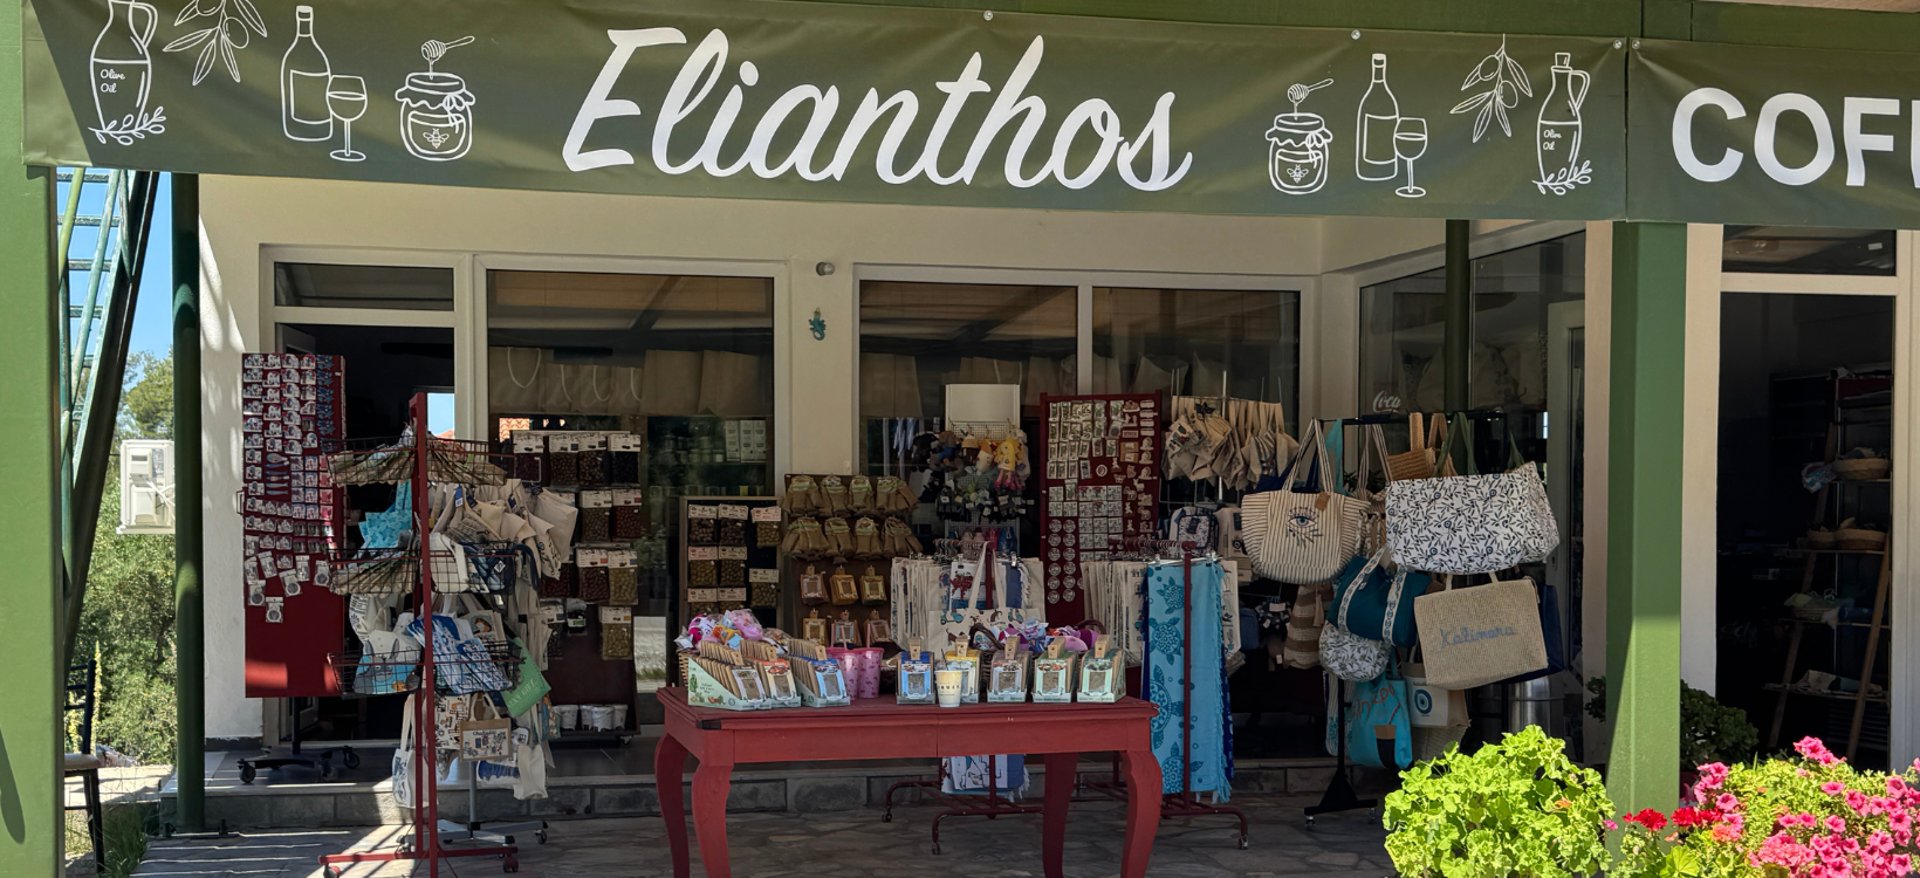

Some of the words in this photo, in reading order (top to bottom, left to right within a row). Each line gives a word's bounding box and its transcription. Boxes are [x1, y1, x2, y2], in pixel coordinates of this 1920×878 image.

[101, 69, 125, 80] Olive
[101, 83, 117, 93] Oil
[561, 27, 1192, 191] Elianthos
[1543, 142, 1555, 151] Oil
[1372, 390, 1400, 413] Coca
